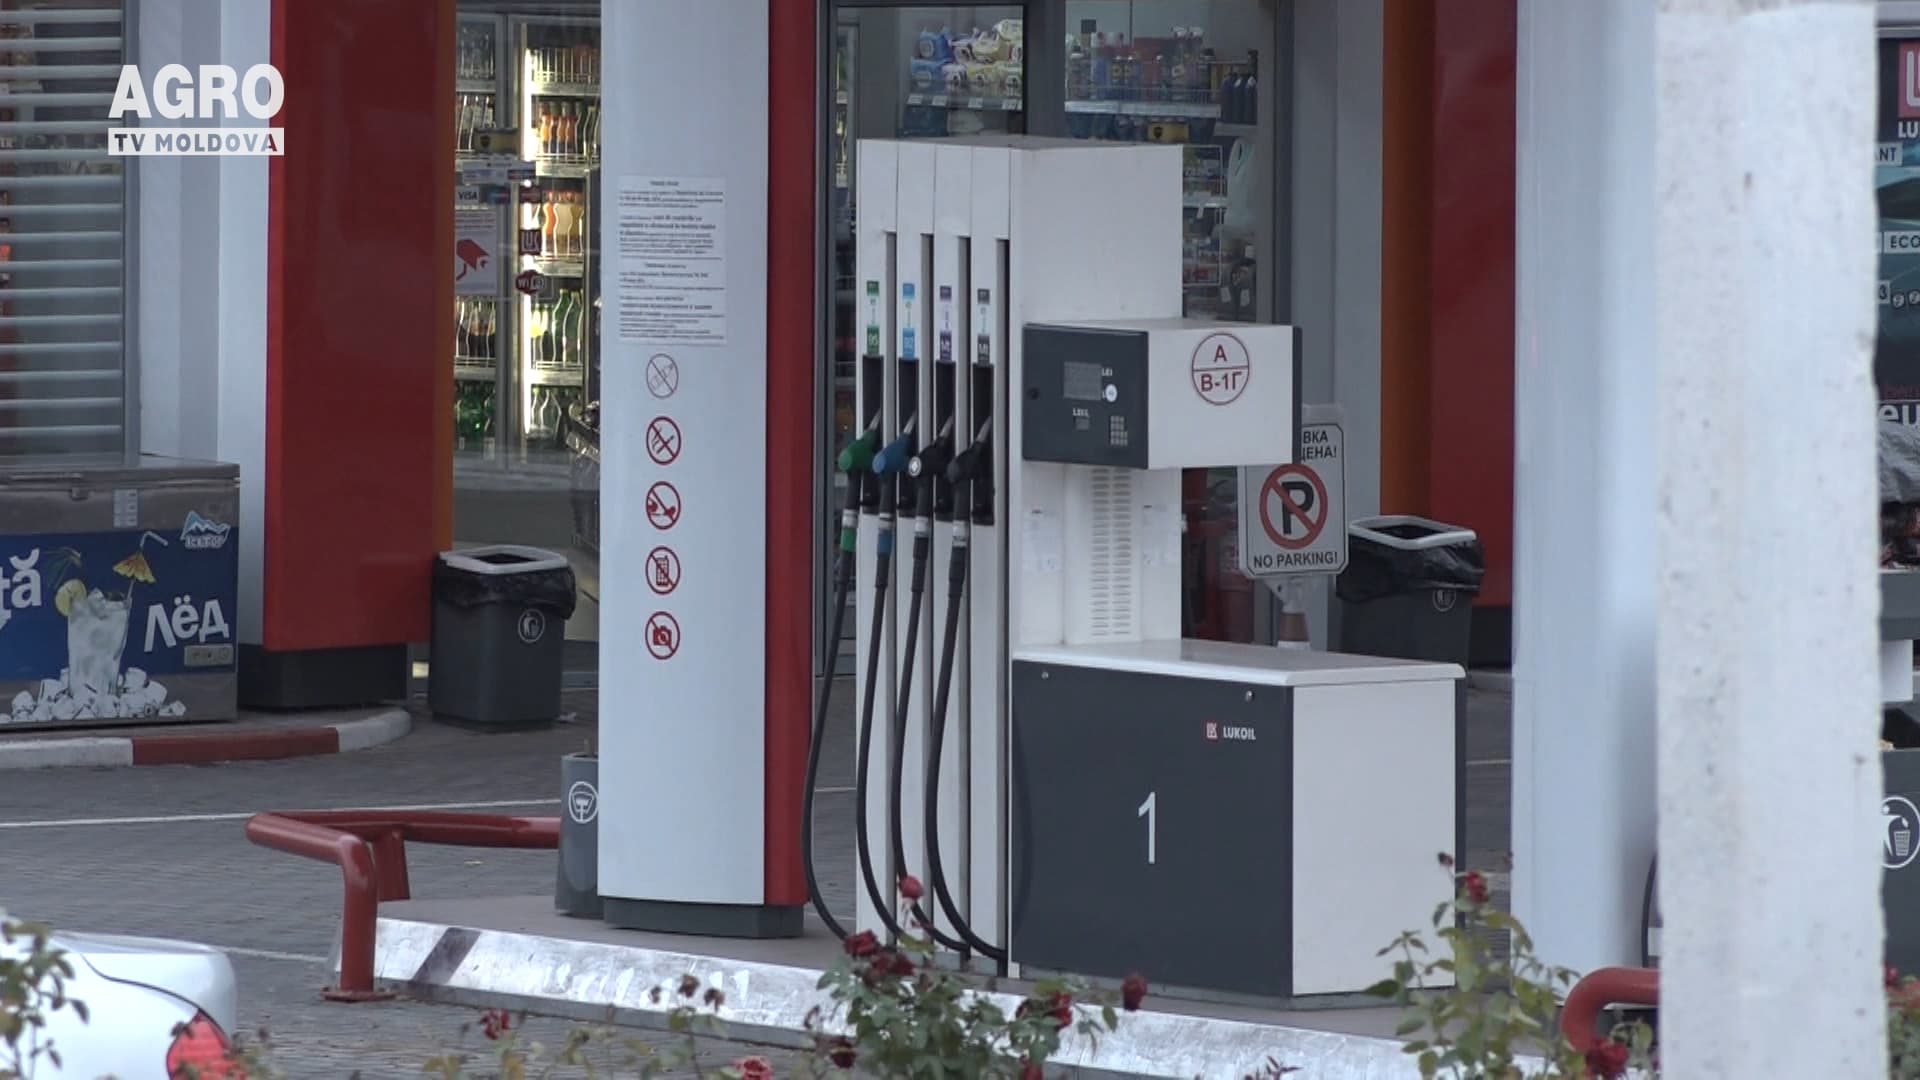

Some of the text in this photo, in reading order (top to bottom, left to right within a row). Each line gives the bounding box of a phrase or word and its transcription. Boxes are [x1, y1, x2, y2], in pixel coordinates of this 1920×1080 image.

[1875, 147, 1897, 162] NT
[458, 190, 478, 201] VISA
[1253, 551, 1338, 569] NO PARKING!
[144, 594, 230, 653] Лёд
[1223, 726, 1256, 740] LUKOIL
[1137, 790, 1156, 865] 1
